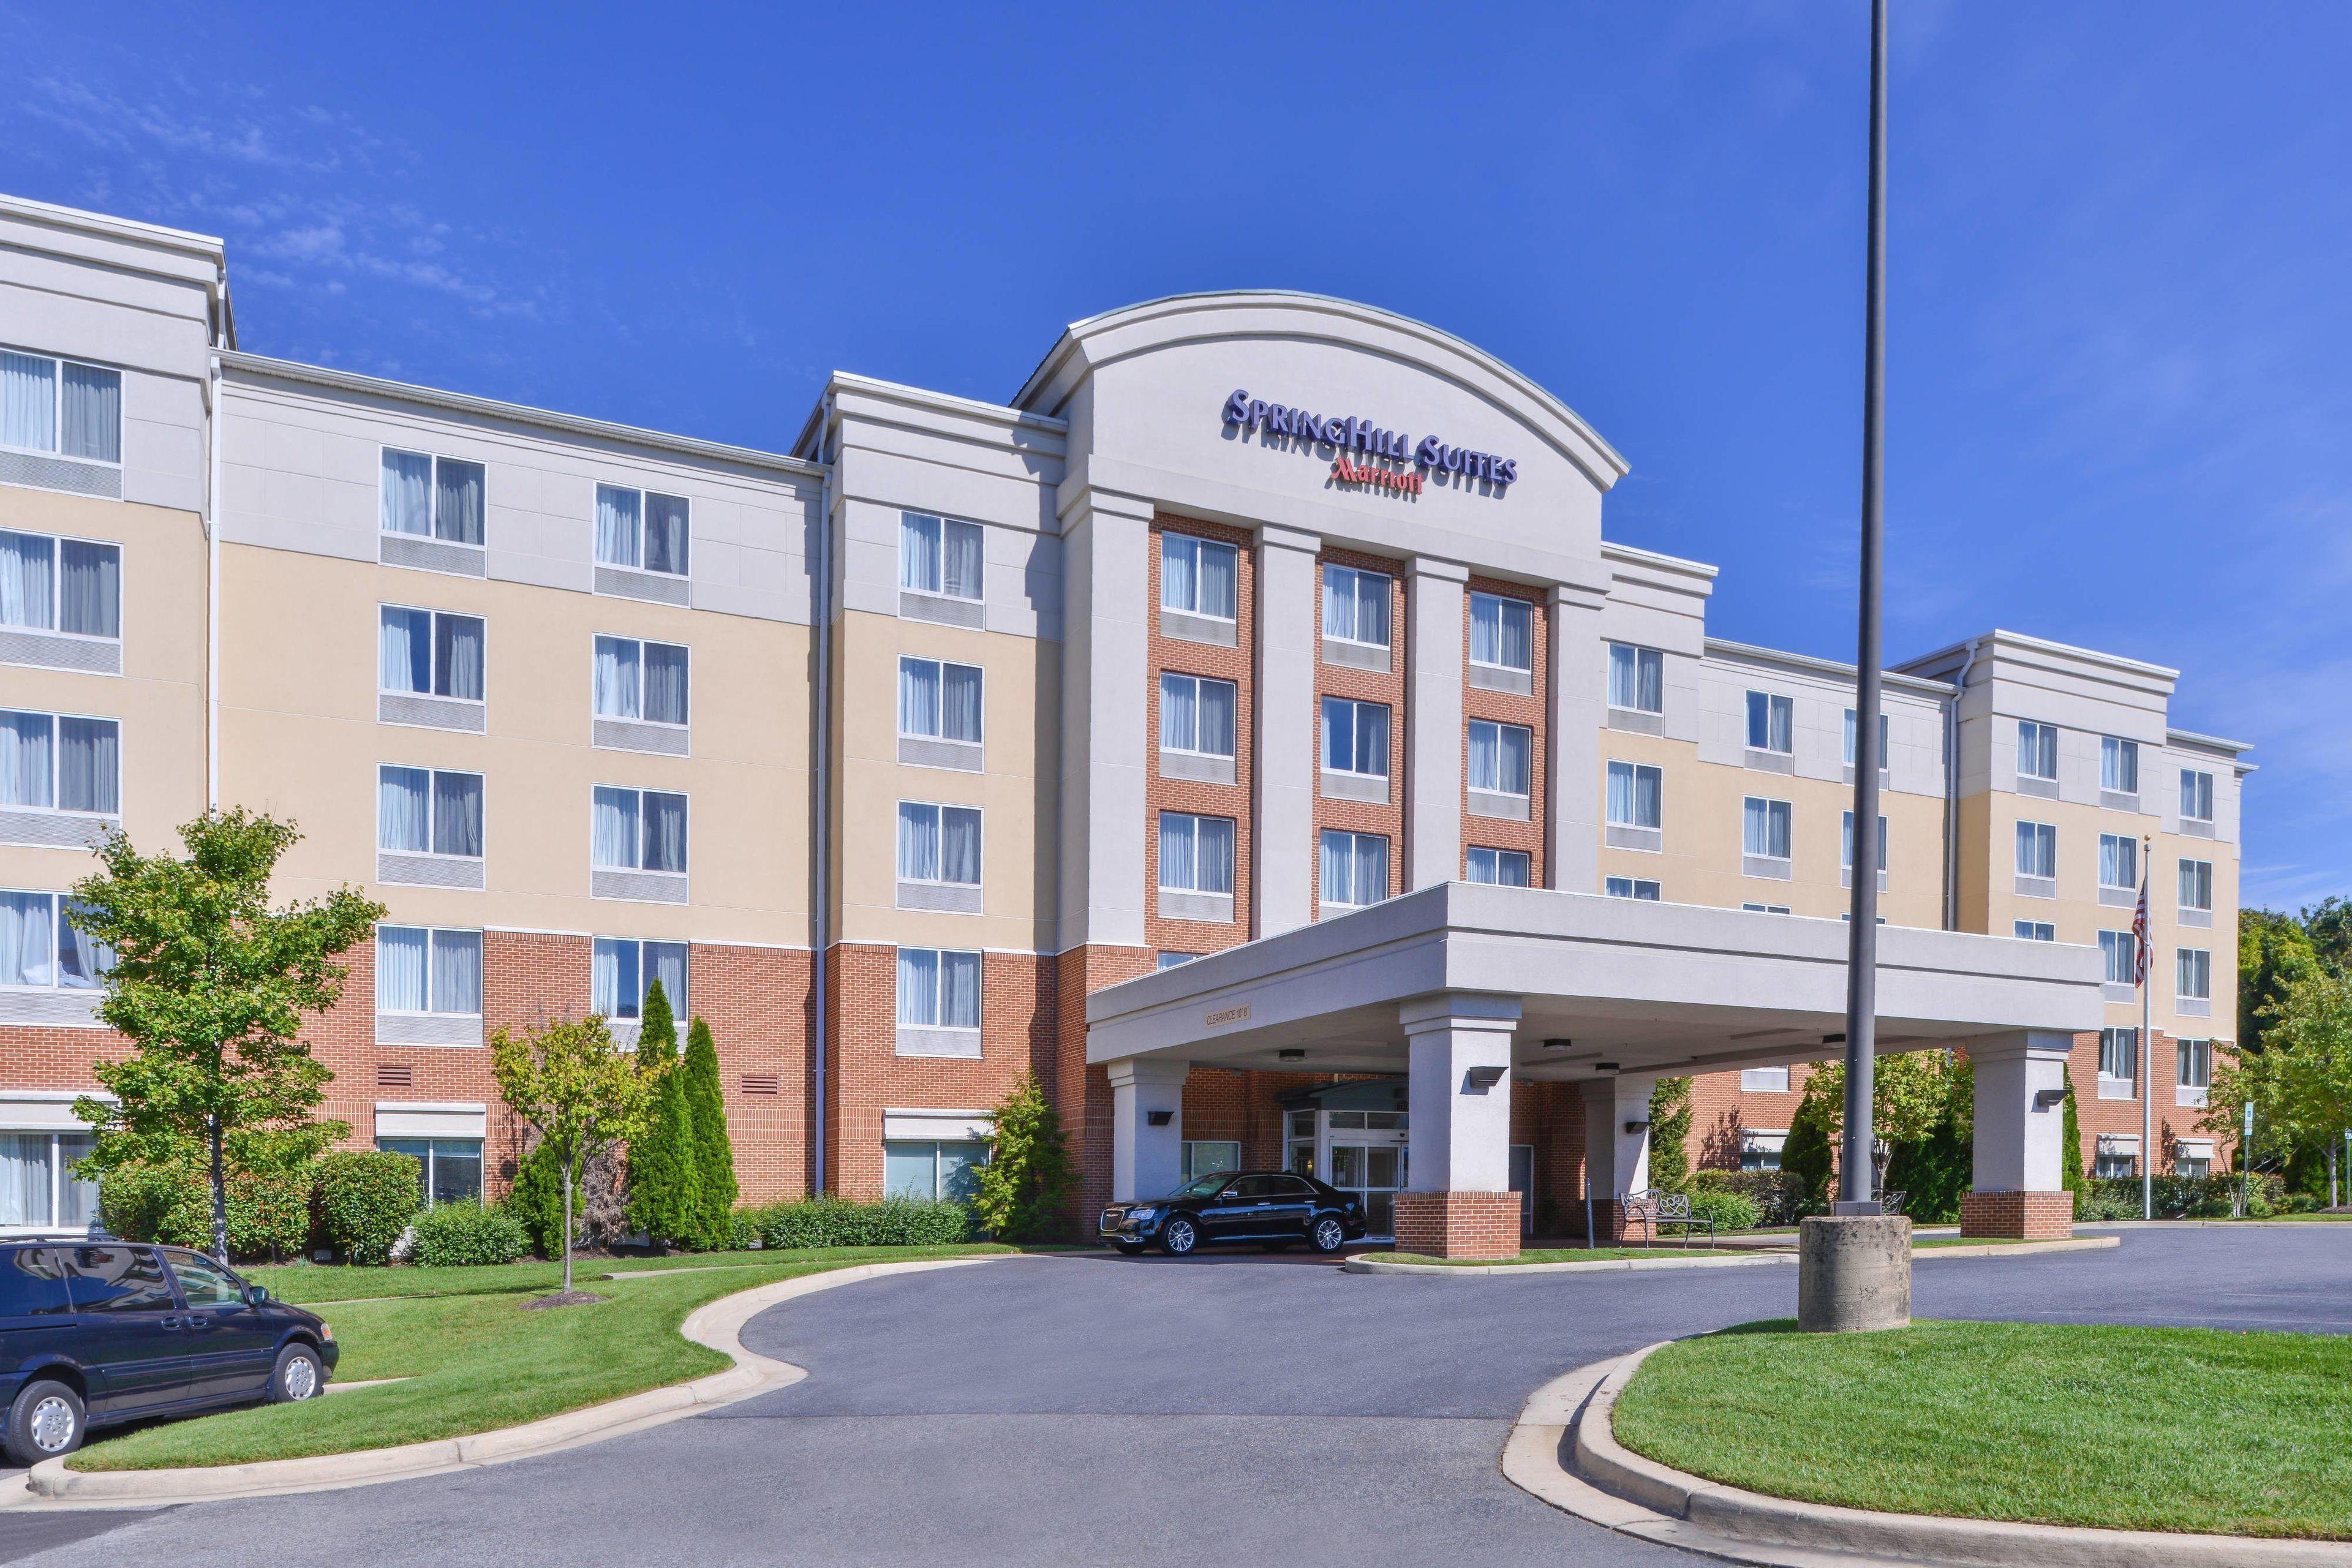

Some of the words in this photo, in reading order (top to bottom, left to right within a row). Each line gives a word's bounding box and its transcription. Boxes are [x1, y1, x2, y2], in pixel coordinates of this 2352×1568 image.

[1330, 454, 1423, 495] Marriott
[1421, 434, 1518, 484] SUITES
[1207, 1009, 1236, 1025] CLEARANCE
